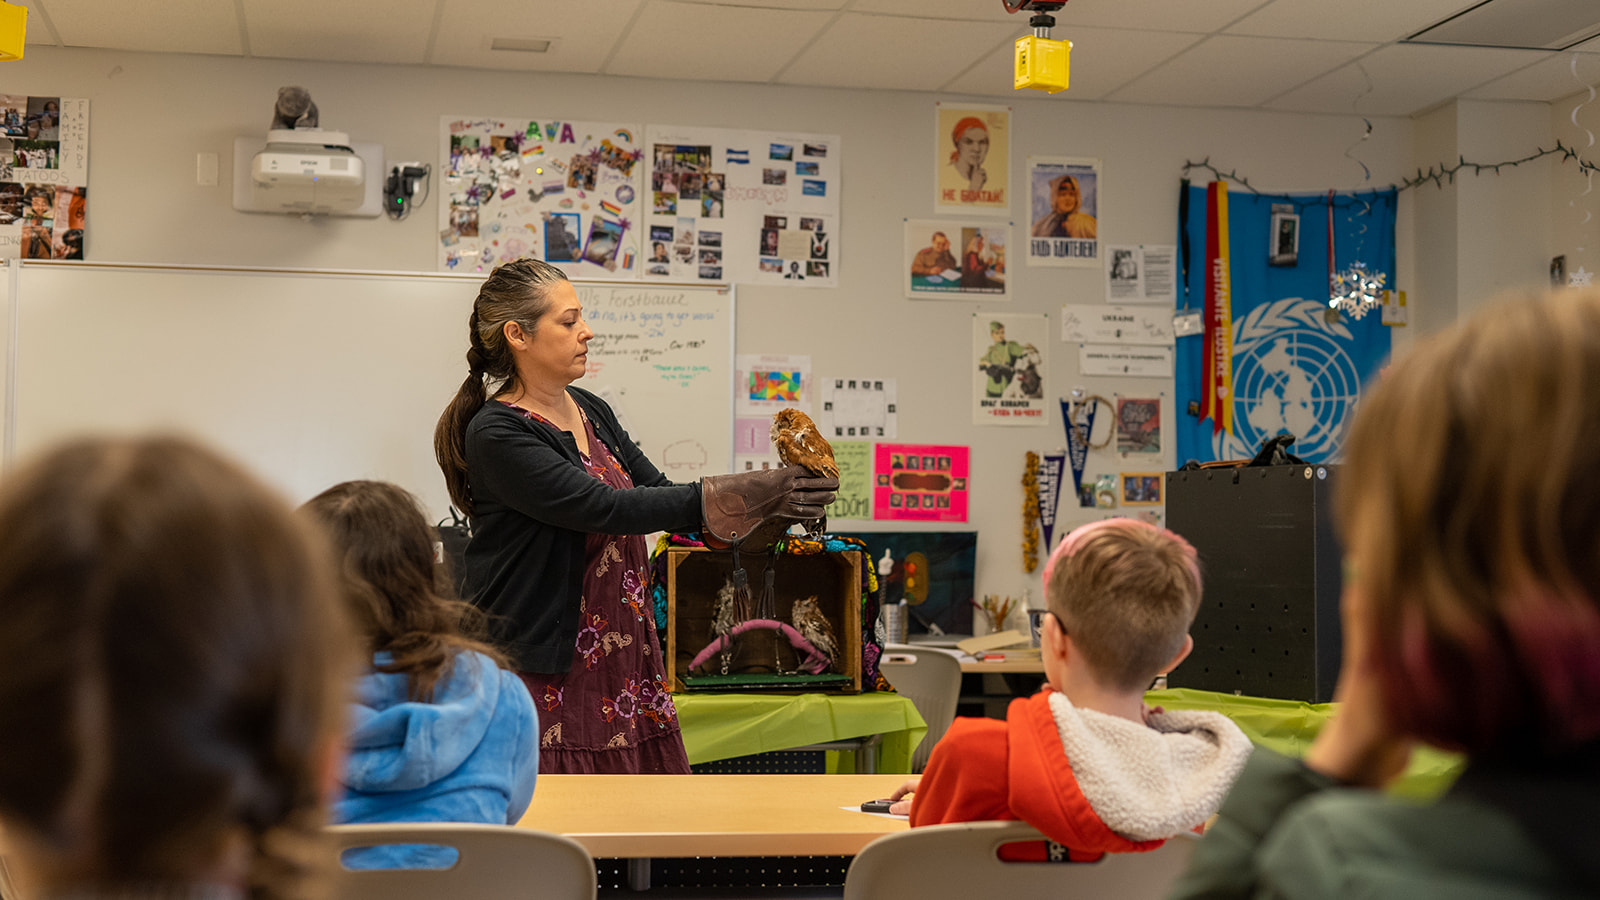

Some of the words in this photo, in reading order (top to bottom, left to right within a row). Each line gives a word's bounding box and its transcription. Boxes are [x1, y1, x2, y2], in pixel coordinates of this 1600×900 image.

[525, 121, 576, 144] AVA
[16, 169, 70, 184] TATOOS
[942, 188, 956, 201] НЕ
[1213, 258, 1228, 321] VISITANTE
[1102, 314, 1135, 323] UKRAINE
[1214, 327, 1229, 378] ILUSTRE
